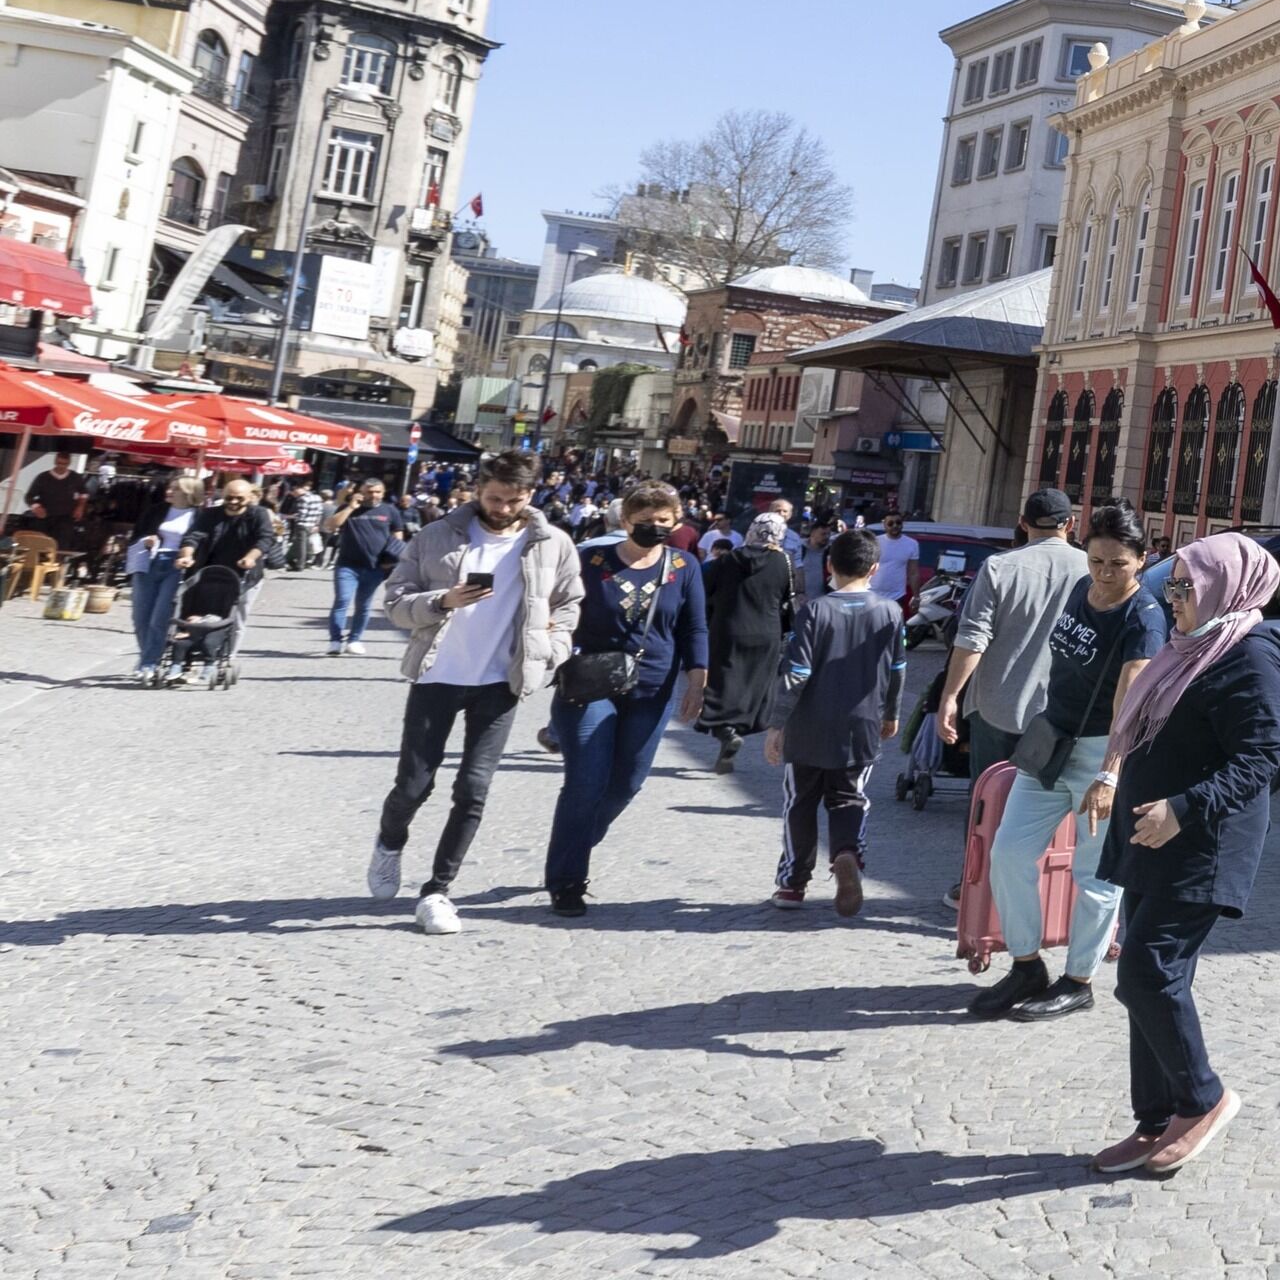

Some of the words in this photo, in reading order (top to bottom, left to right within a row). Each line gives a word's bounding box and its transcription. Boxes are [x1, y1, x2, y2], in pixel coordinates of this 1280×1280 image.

[243, 426, 287, 441] TADINI
[288, 430, 329, 445] ÇIKAR
[1071, 623, 1098, 645] ME!
